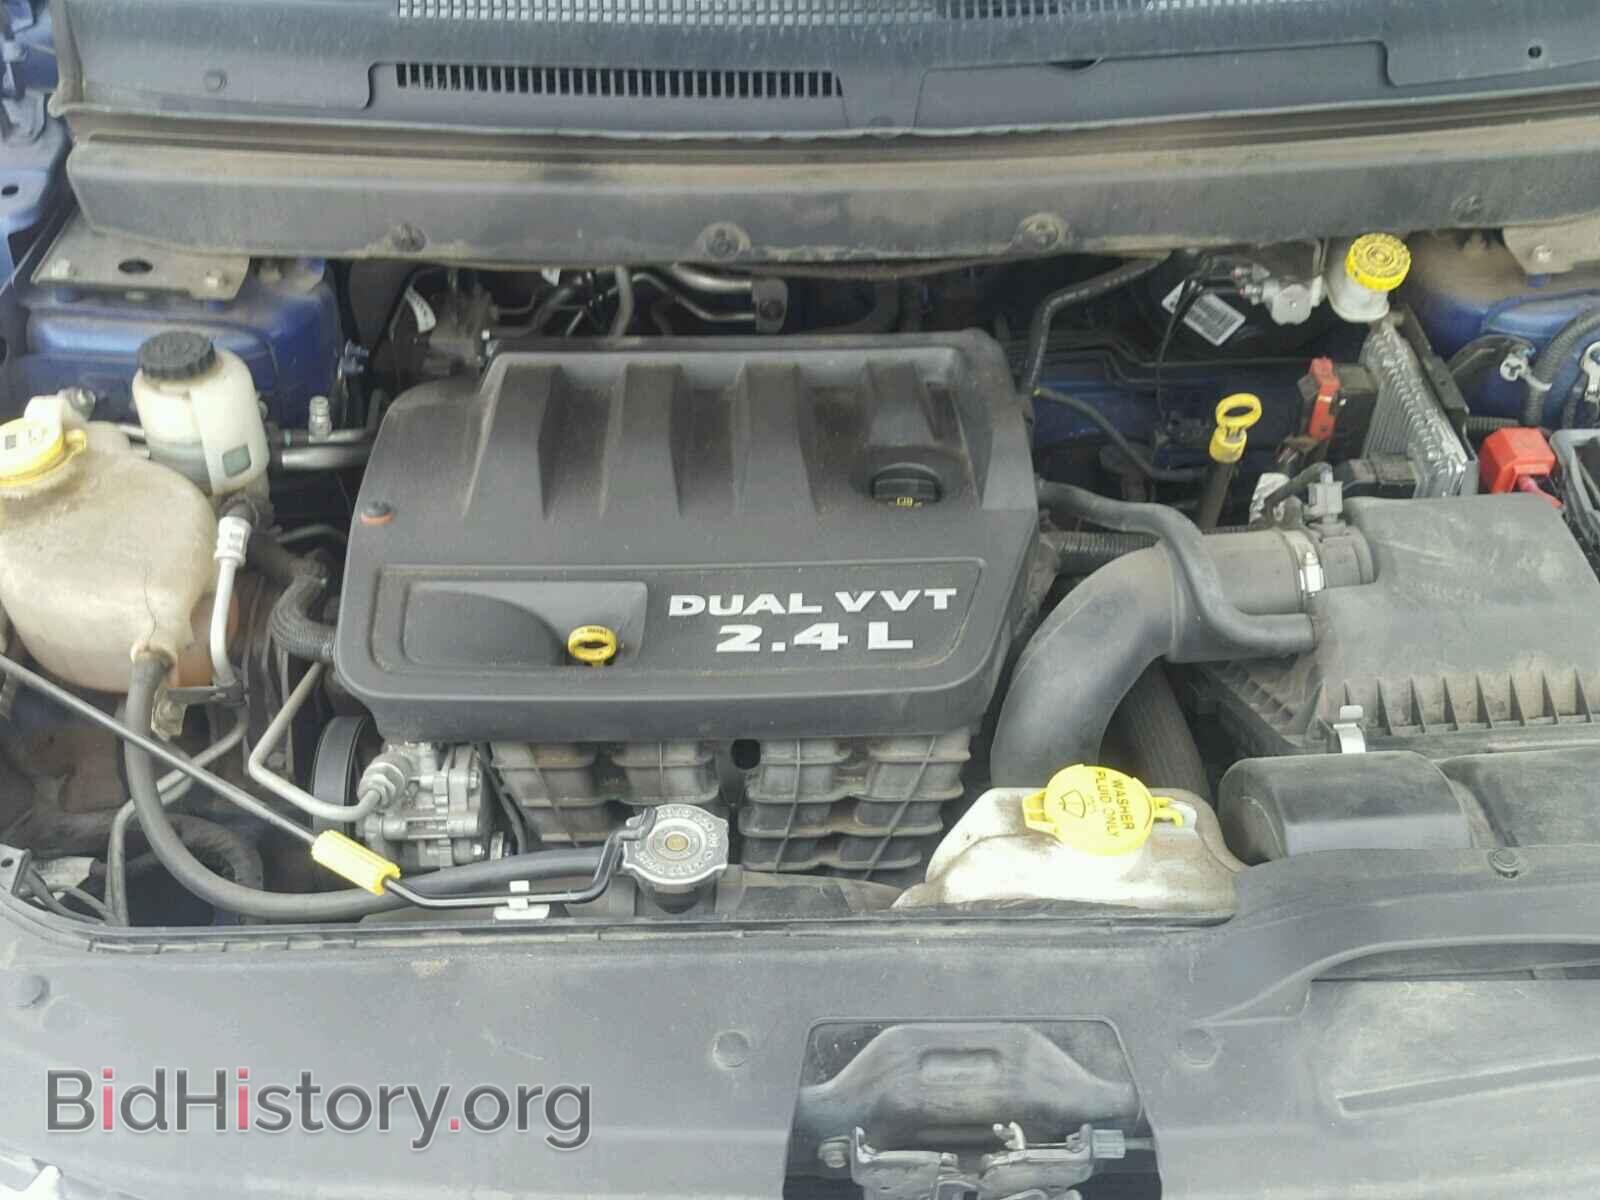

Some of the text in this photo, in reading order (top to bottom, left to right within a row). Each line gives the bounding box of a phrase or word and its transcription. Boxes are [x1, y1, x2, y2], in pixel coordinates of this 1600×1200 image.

[668, 588, 958, 617] DUAL VVT
[1097, 770, 1120, 838] FLUID ONLY
[1113, 779, 1135, 830] WASHER
